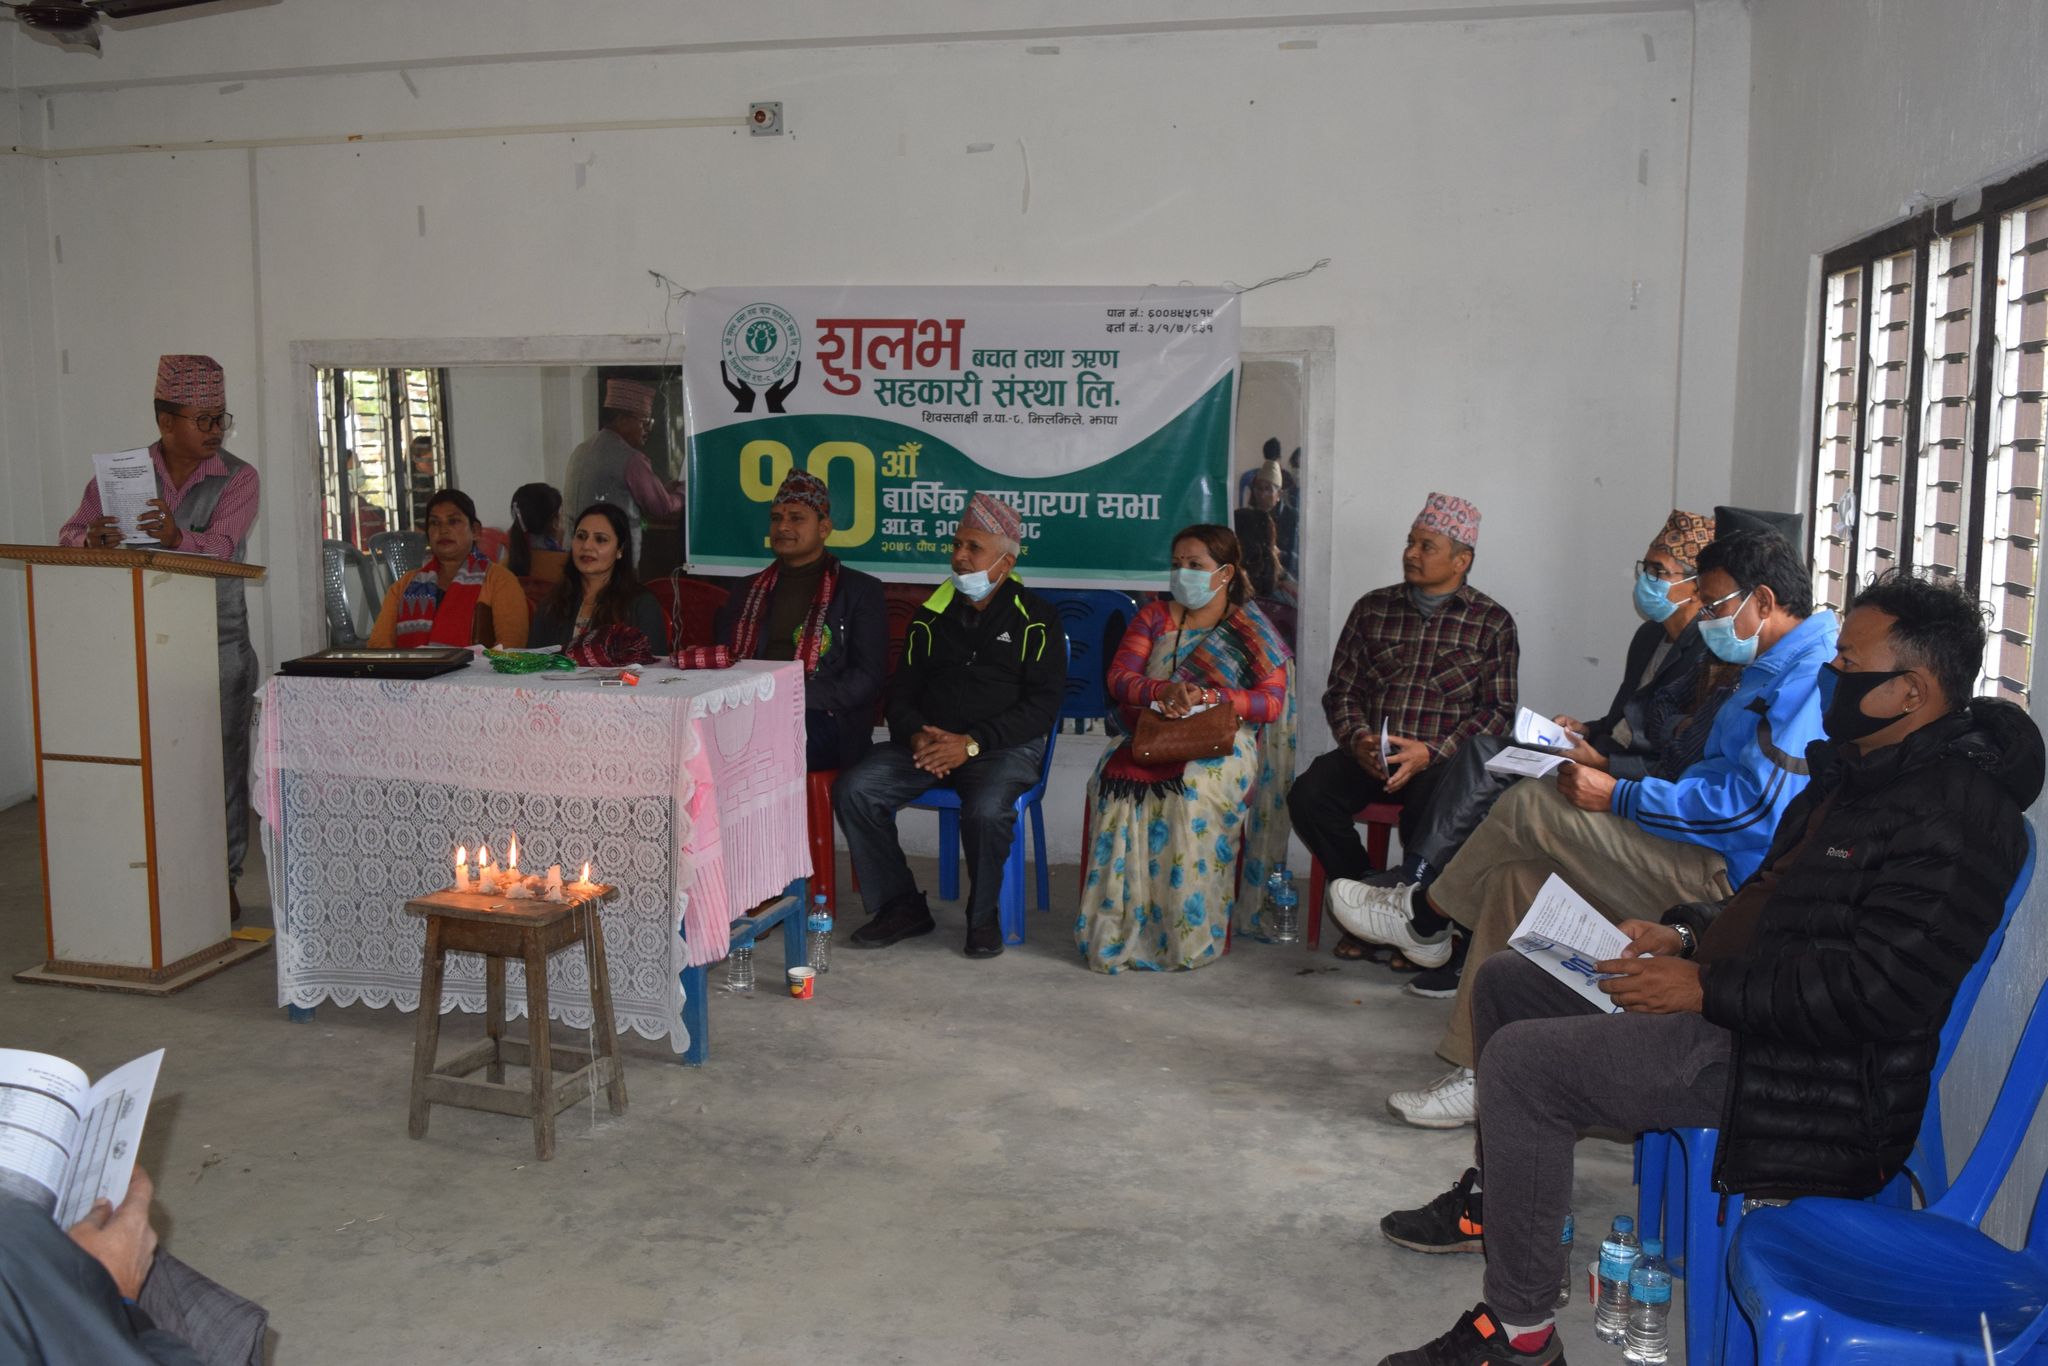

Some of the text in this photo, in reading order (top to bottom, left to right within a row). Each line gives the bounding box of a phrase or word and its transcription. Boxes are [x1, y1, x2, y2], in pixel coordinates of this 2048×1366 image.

[1107, 309, 1126, 318] पान
[816, 318, 965, 396] शुलभ
[972, 350, 1120, 369] बचत तथा ऋण
[874, 371, 1120, 408] सहकारी संस्था लि.
[922, 410, 978, 424] शिवसताक्षी
[1088, 414, 1118, 426] झापा
[882, 481, 1161, 519] बार्षिक ाधारण सभा
